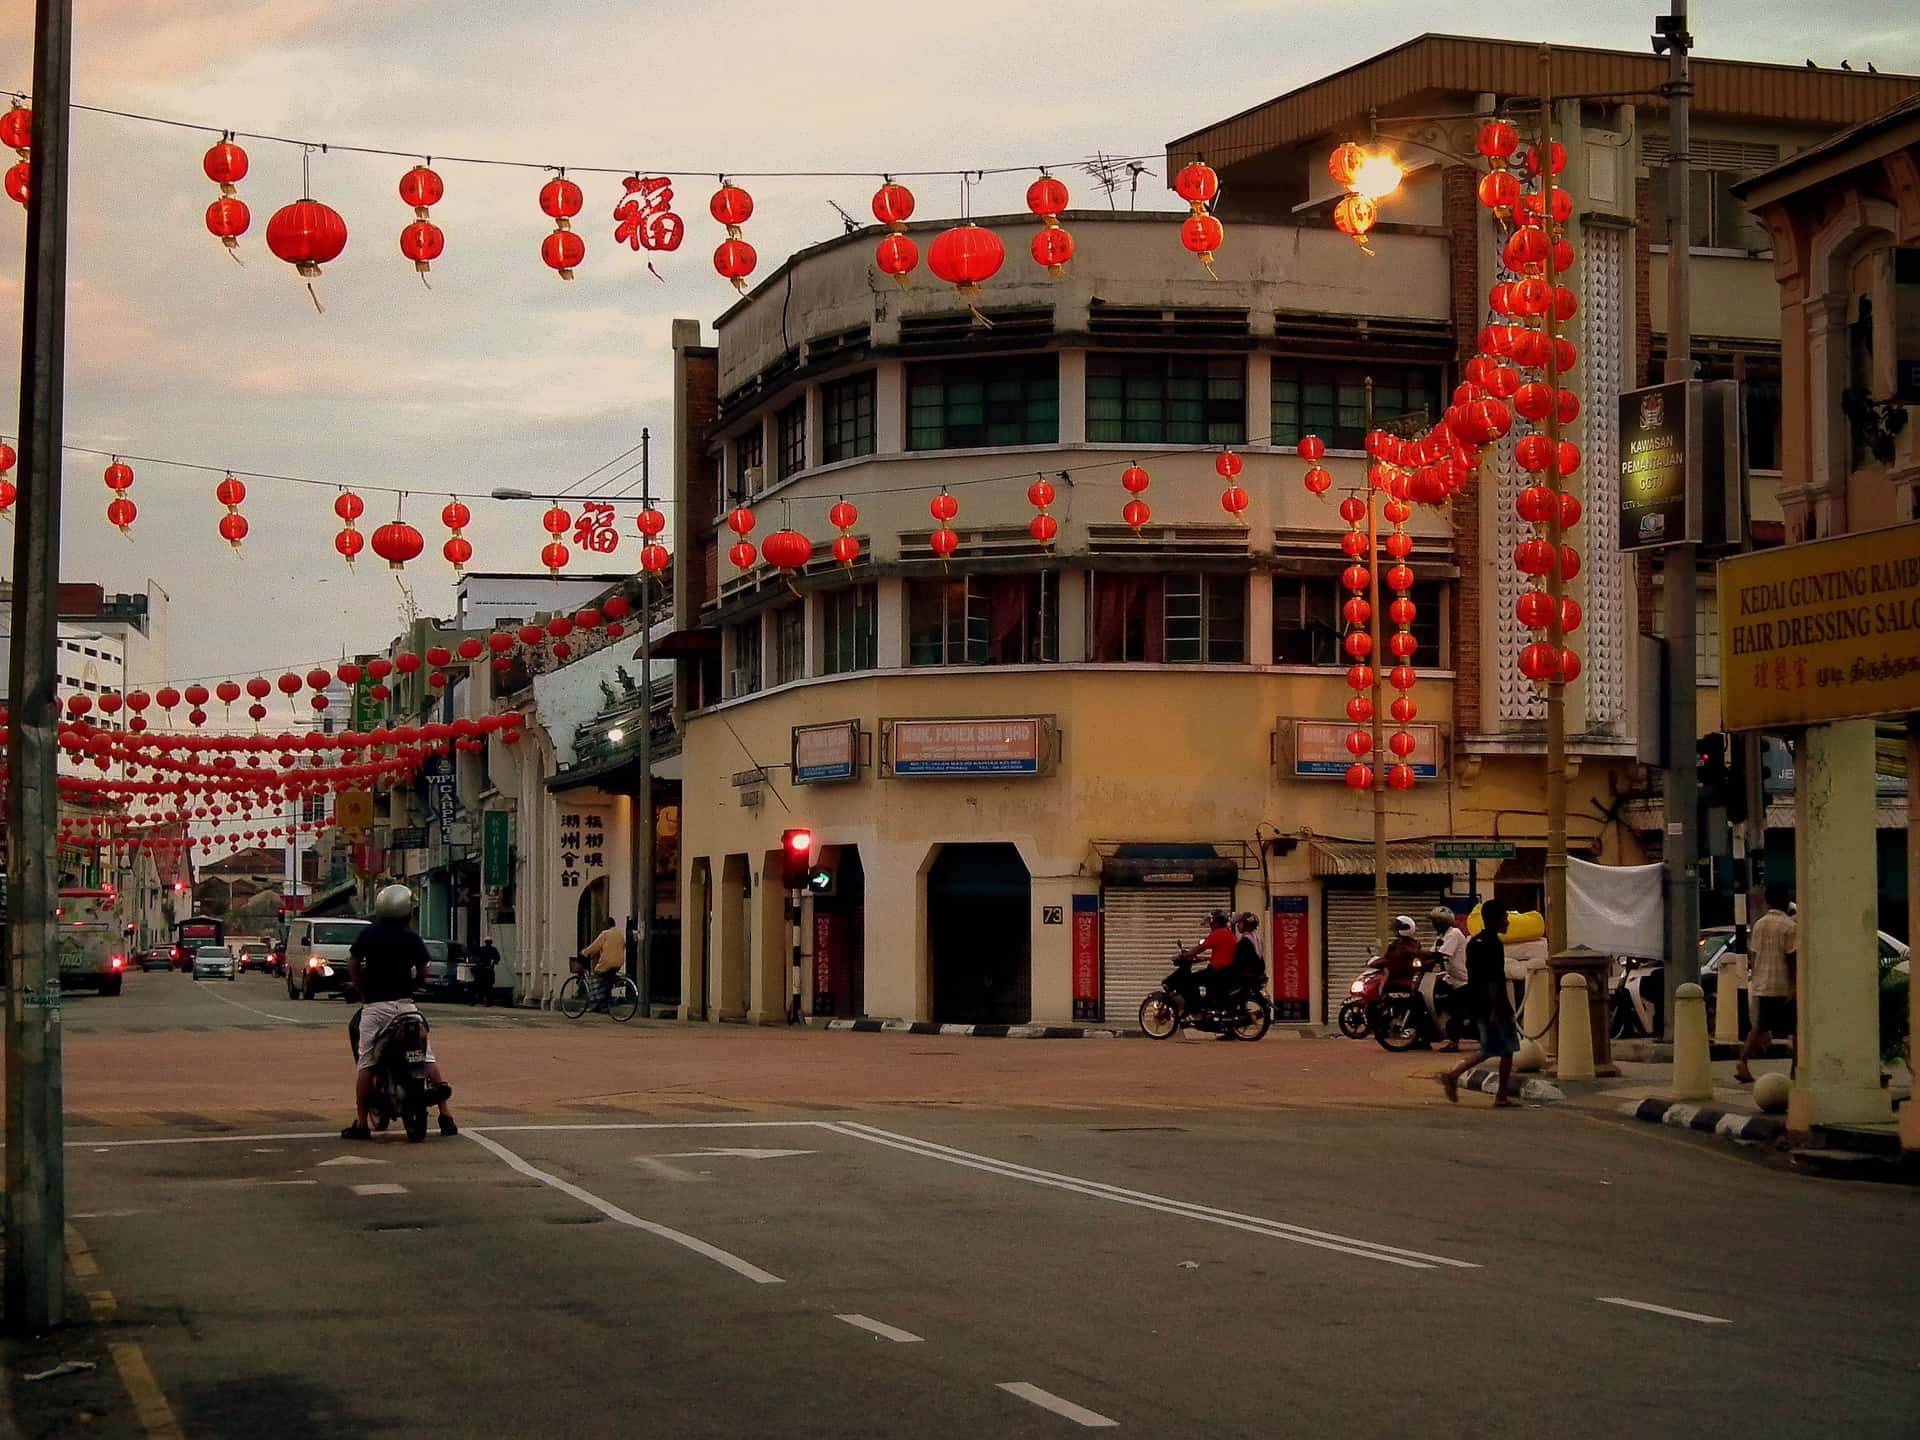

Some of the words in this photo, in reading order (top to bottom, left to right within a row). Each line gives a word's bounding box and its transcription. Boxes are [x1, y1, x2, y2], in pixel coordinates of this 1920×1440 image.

[614, 177, 684, 251] 福
[1621, 454, 1683, 475] PEMANTAUAN
[1630, 436, 1673, 454] KAWASAN
[574, 501, 619, 553] 福
[1738, 581, 1787, 616] KEDAI
[1788, 566, 1867, 607] GUNTING
[1871, 555, 1920, 594] RAMB
[1732, 621, 1775, 655] HAIR
[1776, 606, 1871, 649] DRESSING
[560, 814, 581, 888] 潮州會館
[1044, 908, 1063, 924] 73
